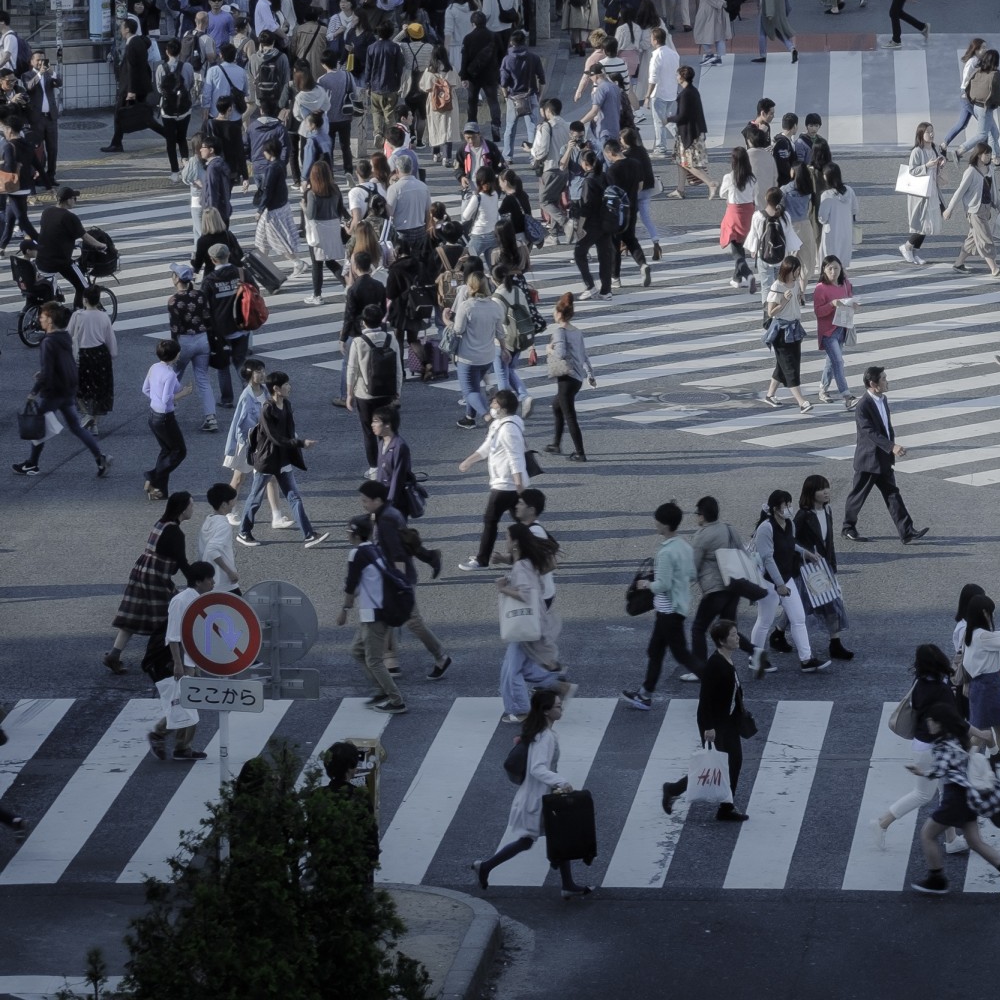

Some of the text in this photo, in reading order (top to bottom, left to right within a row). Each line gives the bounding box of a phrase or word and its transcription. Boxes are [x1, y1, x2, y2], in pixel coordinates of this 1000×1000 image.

[187, 686, 257, 706] ここから
[697, 767, 723, 787] H&M
